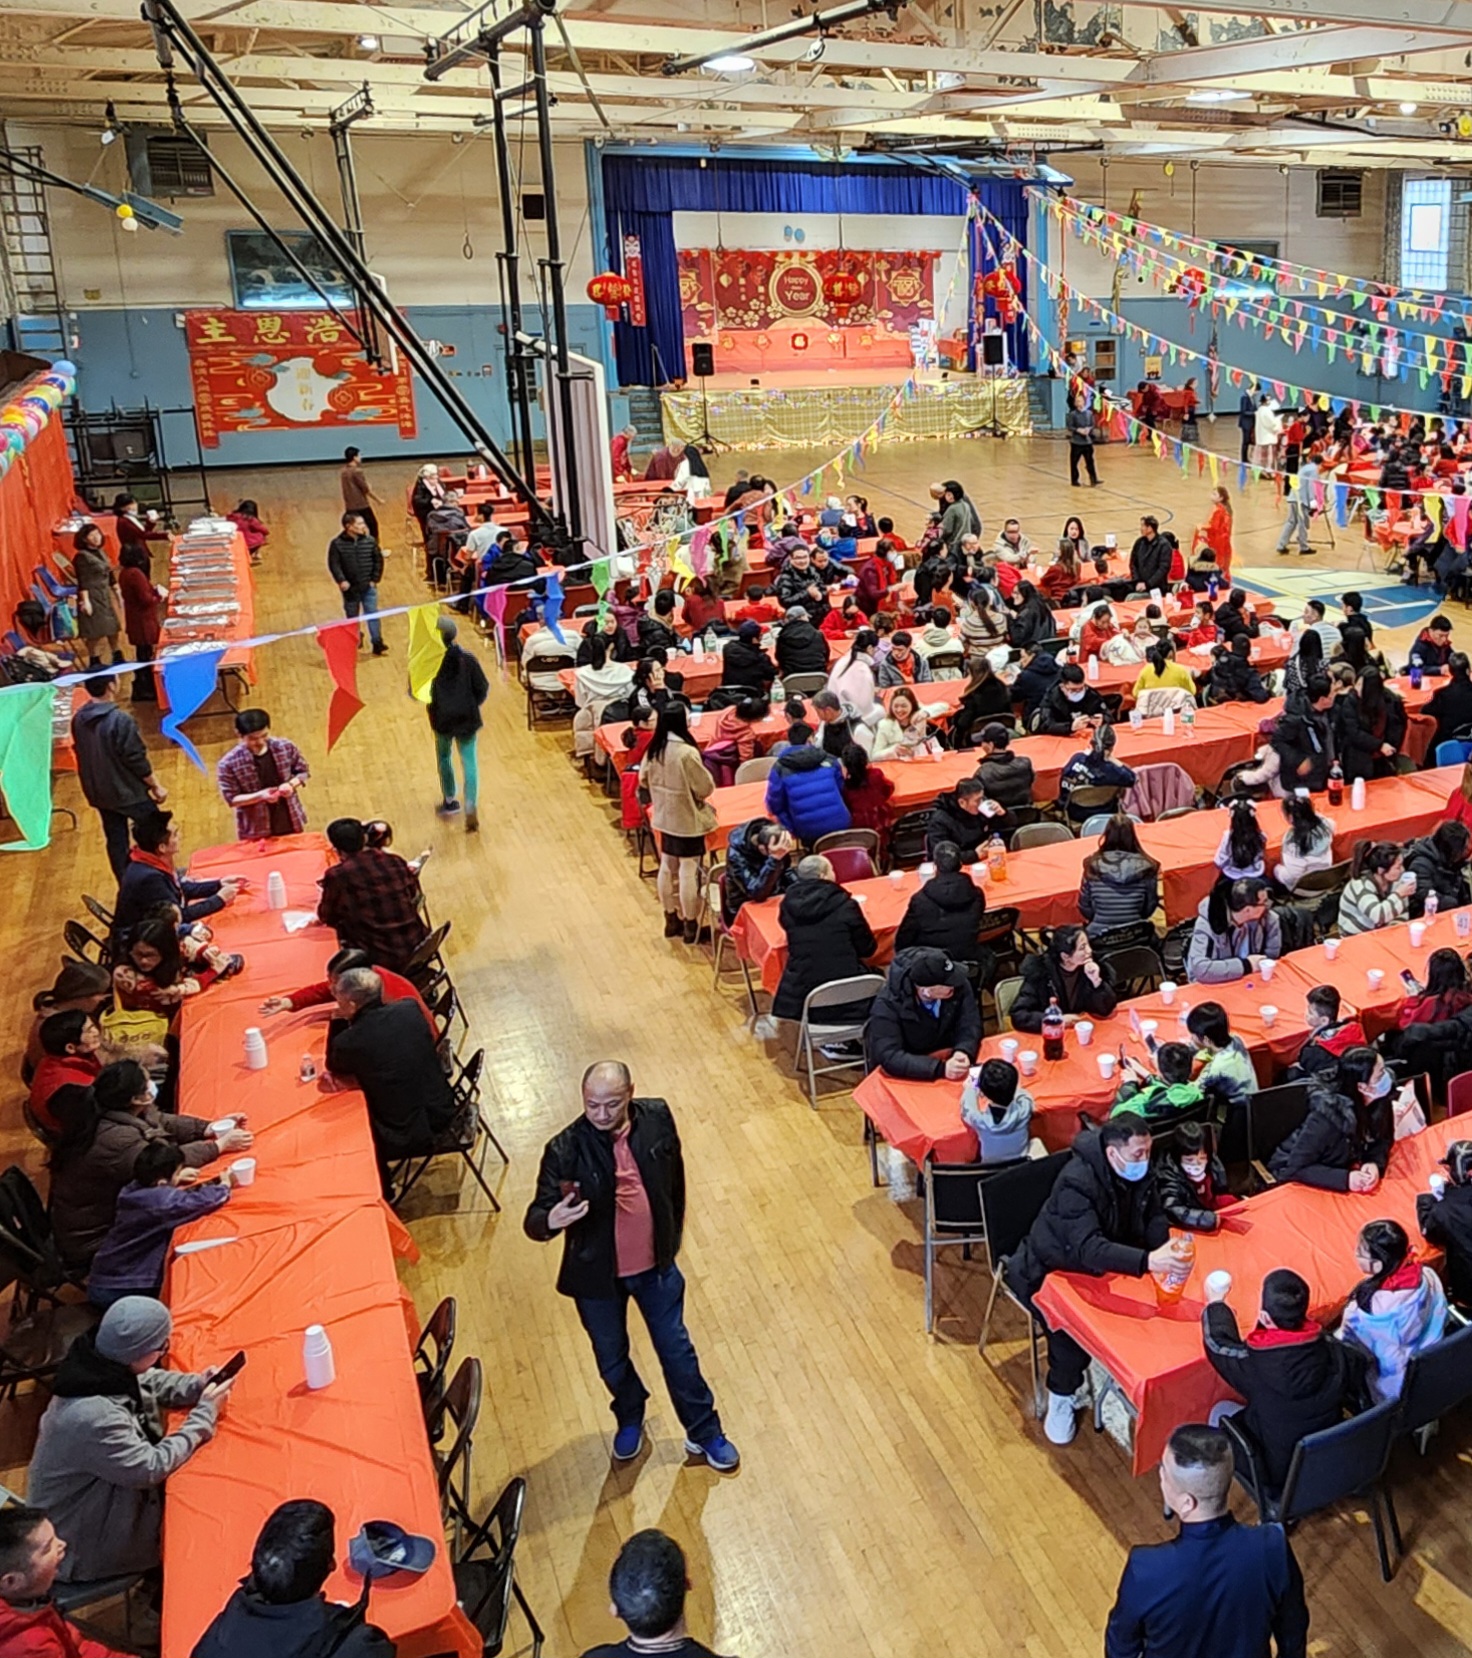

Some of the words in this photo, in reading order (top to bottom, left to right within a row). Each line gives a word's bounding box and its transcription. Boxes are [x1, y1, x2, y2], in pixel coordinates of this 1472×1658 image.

[784, 276, 809, 285] Happy
[784, 290, 811, 301] Year
[196, 315, 345, 344] 主恩浩
